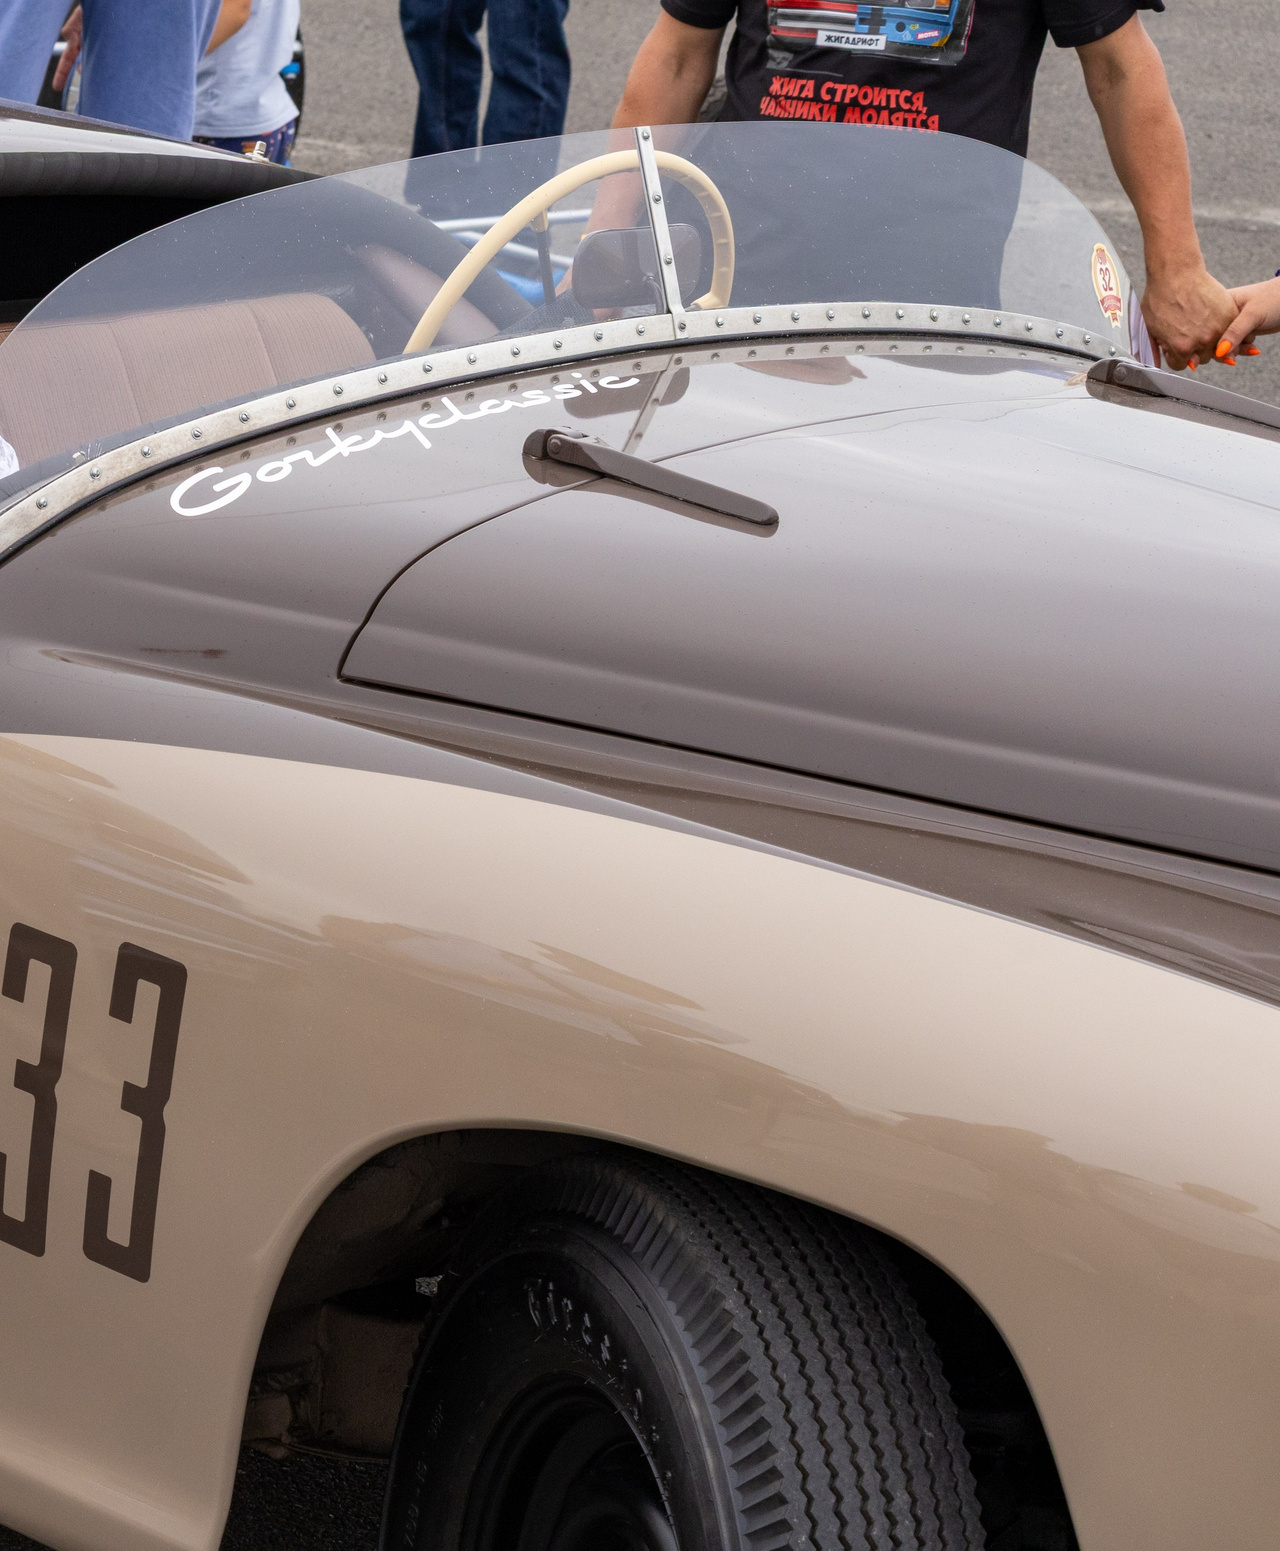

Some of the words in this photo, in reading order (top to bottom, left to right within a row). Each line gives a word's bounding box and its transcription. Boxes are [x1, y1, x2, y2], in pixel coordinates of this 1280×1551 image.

[824, 33, 880, 47] ЖИГАДРИФТ
[916, 30, 939, 39] MOTUL
[768, 75, 815, 98] ЖИГА
[820, 81, 928, 113] СТРОИТСЯ,
[760, 96, 837, 122] ЧАЙНИКИ
[843, 106, 939, 133] МОЛЯТСЯ
[1099, 267, 1113, 292] 32
